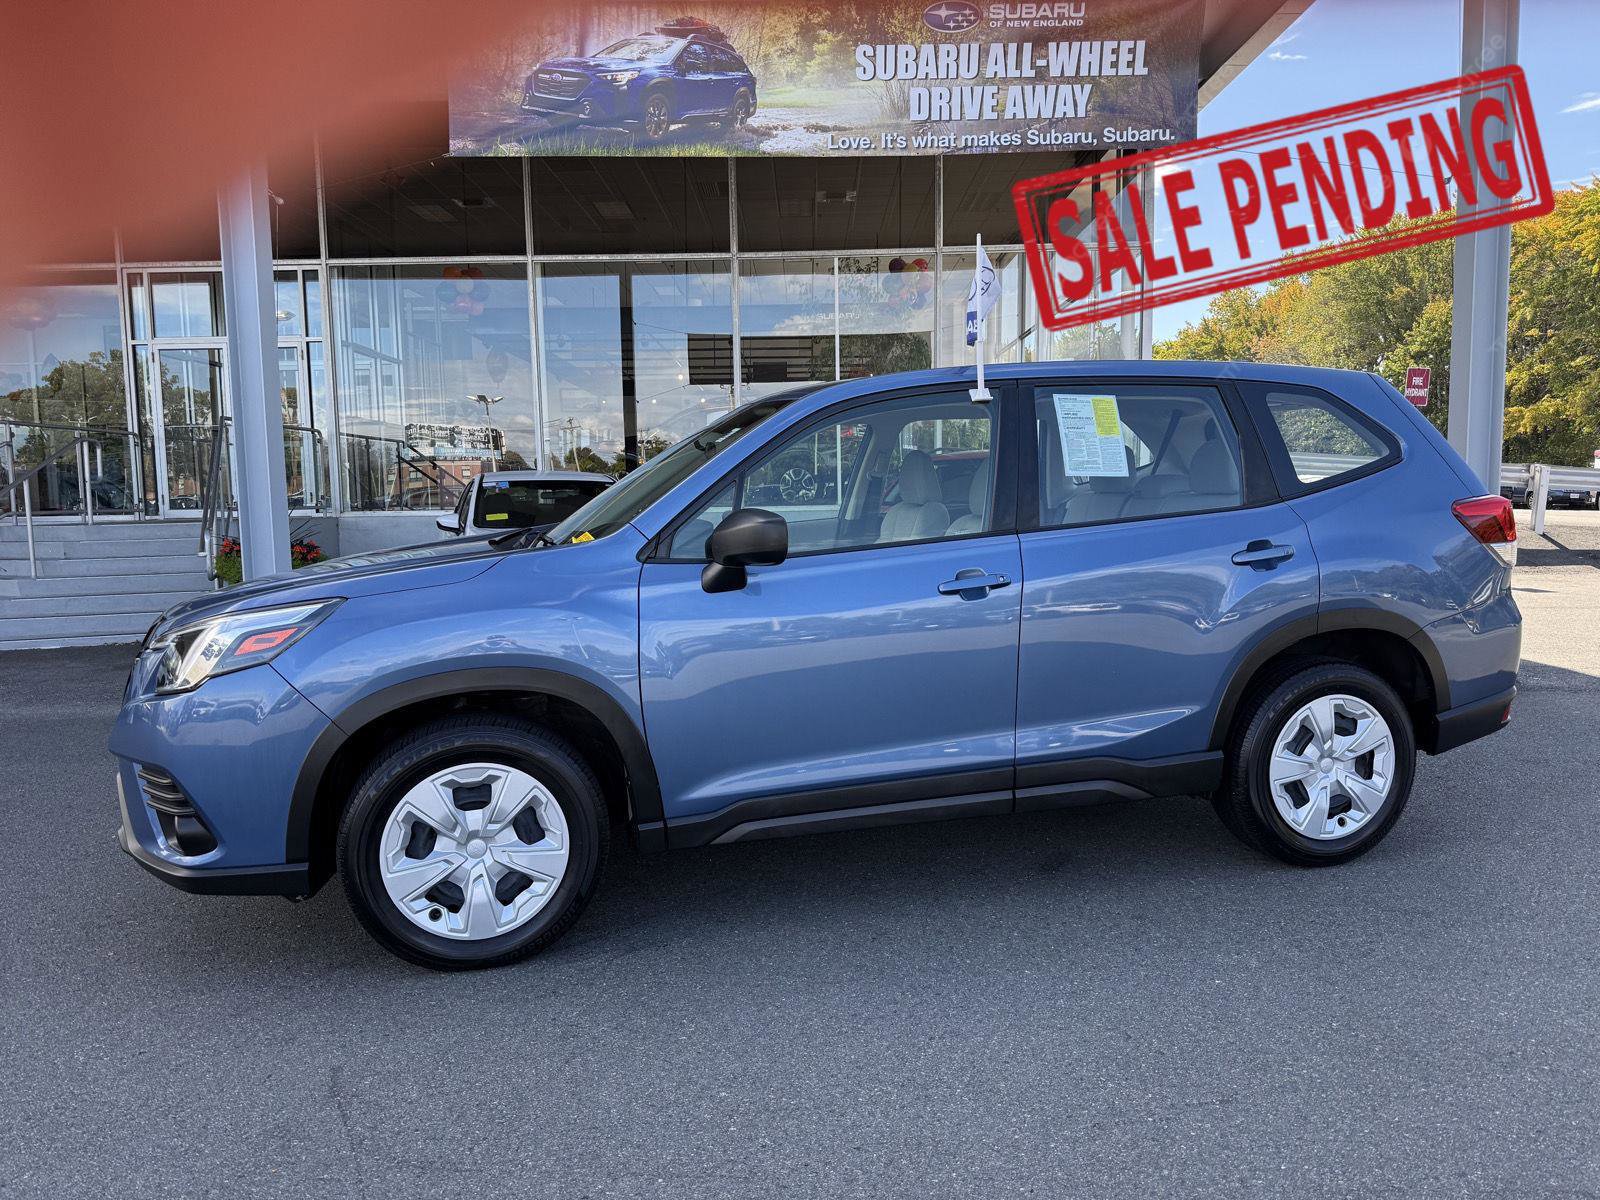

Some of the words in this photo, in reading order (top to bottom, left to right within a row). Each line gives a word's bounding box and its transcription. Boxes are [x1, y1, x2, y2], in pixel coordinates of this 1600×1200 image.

[989, 2, 1086, 19] SUBARU
[989, 20, 1003, 28] OF
[1006, 20, 1030, 28] NEW
[1033, 19, 1084, 27] ENGLAND
[855, 43, 985, 81] SUBARU
[987, 40, 1149, 79] ALL-WHEEL
[910, 85, 999, 121] DRIVE
[1004, 84, 1092, 119] AWAY
[827, 134, 876, 149] Love.
[881, 132, 907, 148] It's
[911, 131, 957, 148] what
[961, 130, 1022, 147] makes
[1026, 128, 1098, 146] Subaru,
[1102, 126, 1175, 143] Subaru.
[1411, 376, 1424, 386] FIRE
